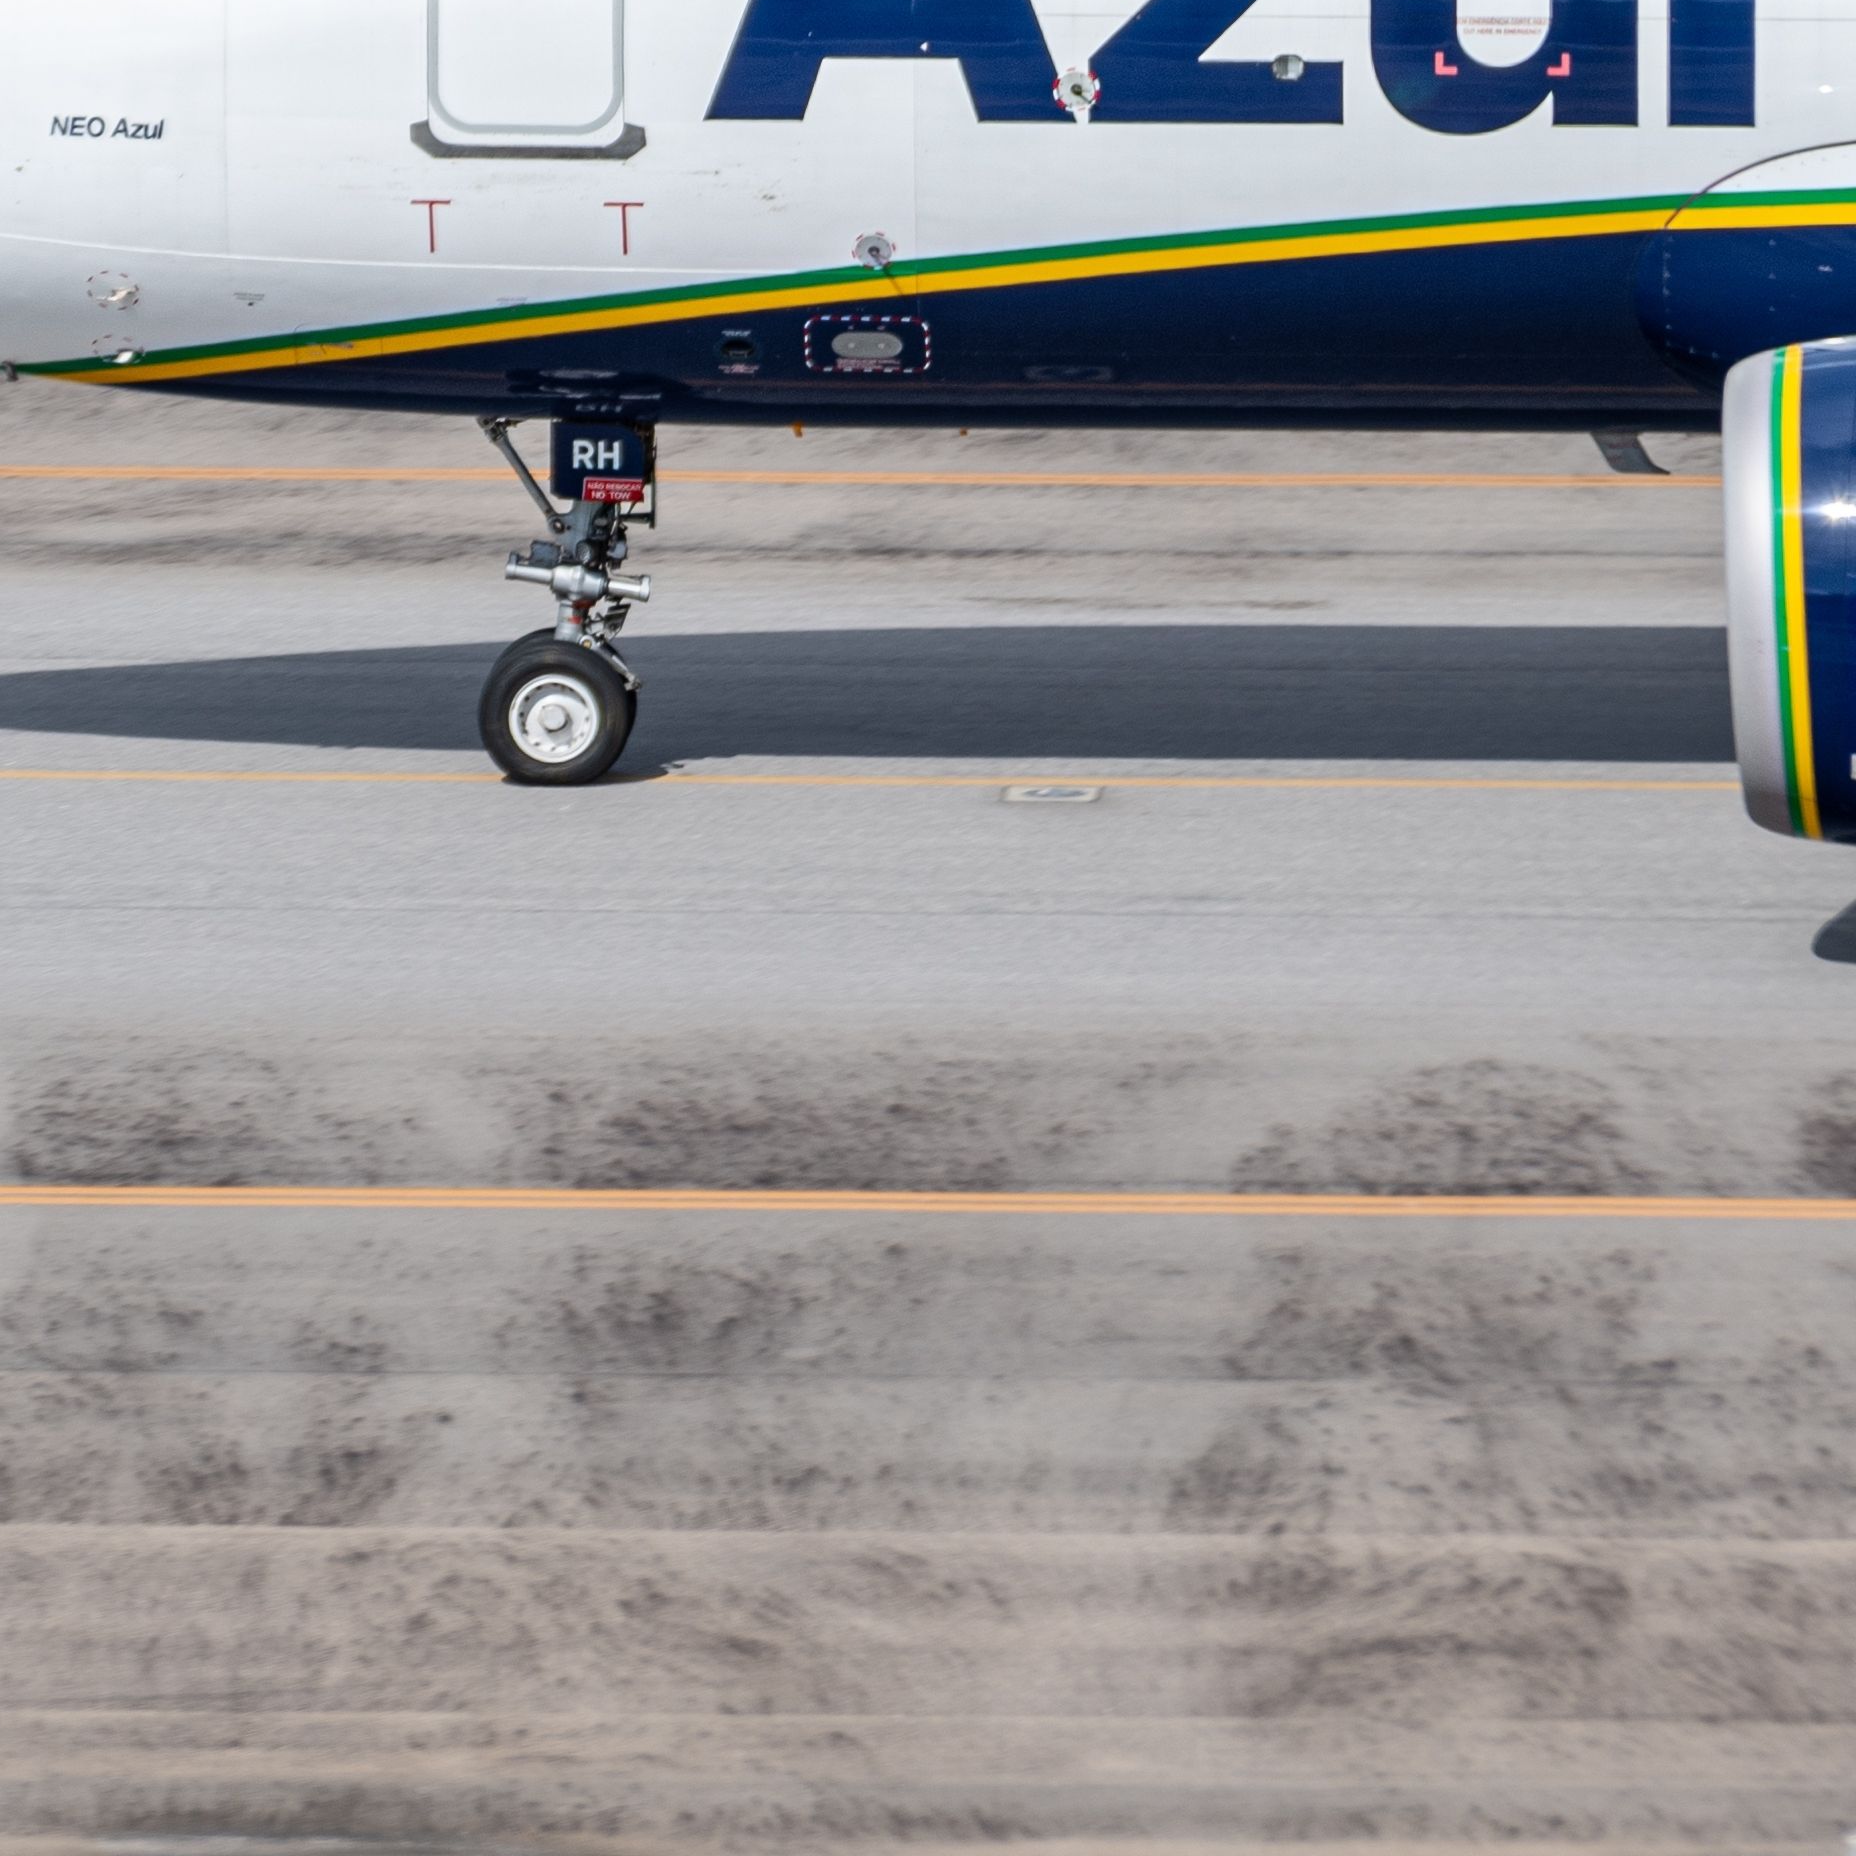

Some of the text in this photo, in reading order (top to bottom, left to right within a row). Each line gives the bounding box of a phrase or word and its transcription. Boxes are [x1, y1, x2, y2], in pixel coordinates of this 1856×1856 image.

[50, 115, 165, 140] NEO Azul
[572, 439, 621, 471] RH
[591, 490, 631, 500] NO TOW
